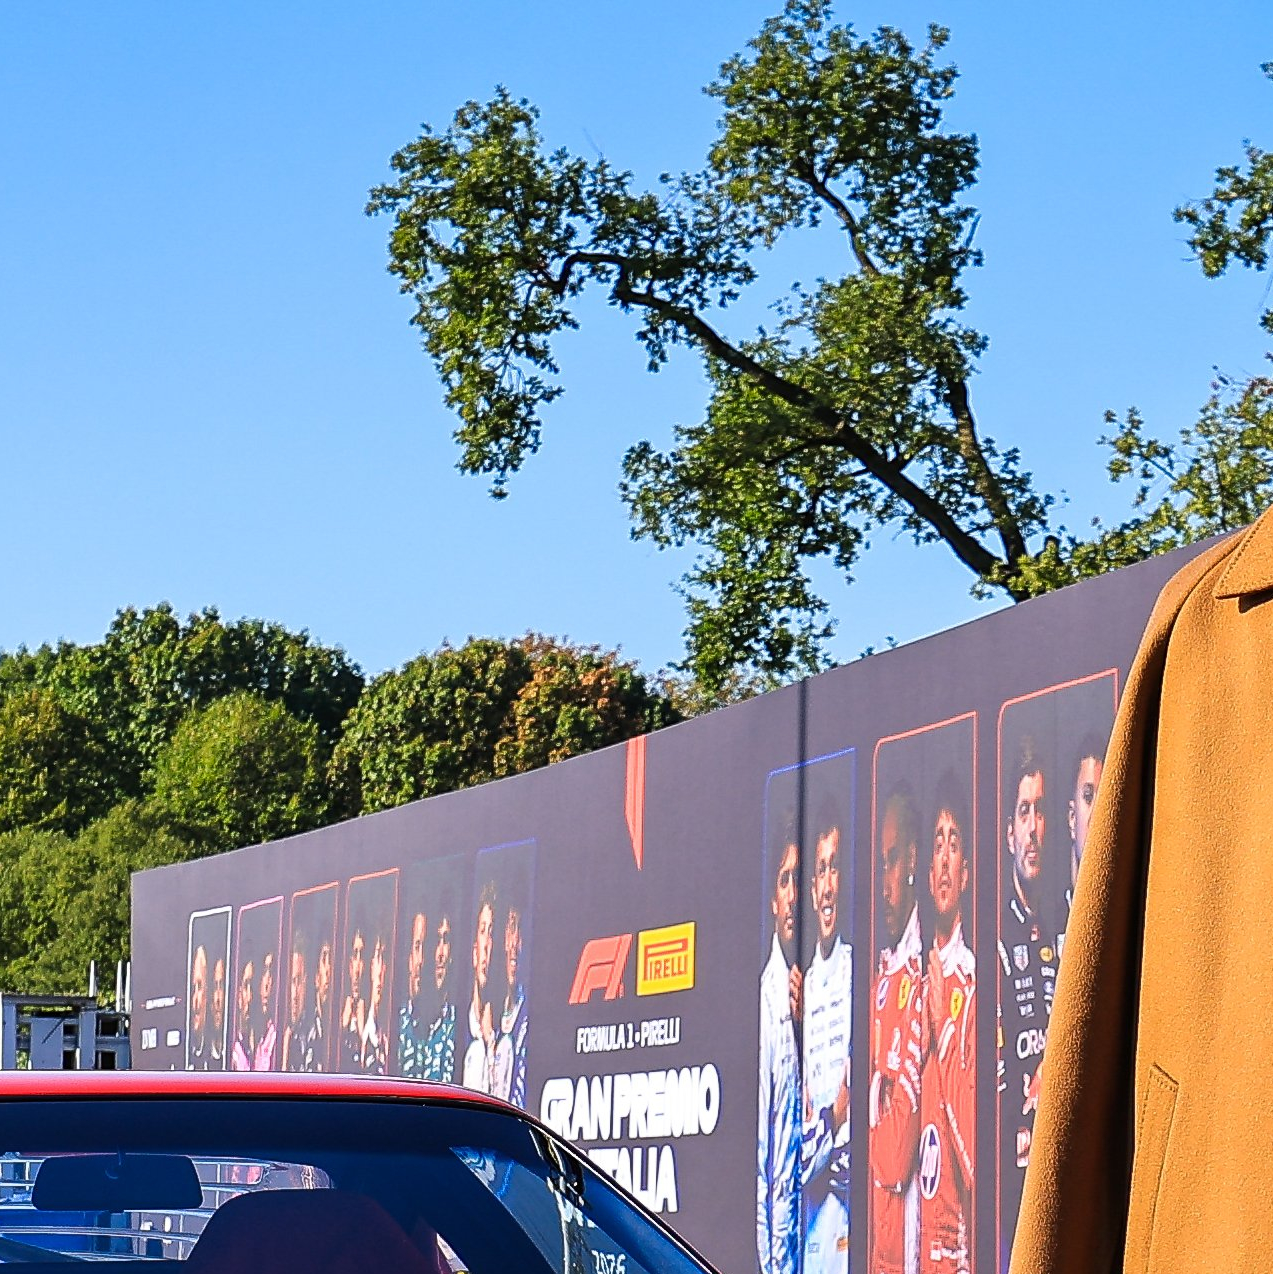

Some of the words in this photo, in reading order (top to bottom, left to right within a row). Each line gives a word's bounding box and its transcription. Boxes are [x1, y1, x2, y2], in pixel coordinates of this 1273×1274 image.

[643, 938, 688, 981] PIRELLI
[576, 1023, 626, 1054] FORMULA
[640, 1017, 681, 1048] PIRELLI
[540, 1073, 613, 1141] GRAN
[612, 1063, 720, 1140] PREMIO
